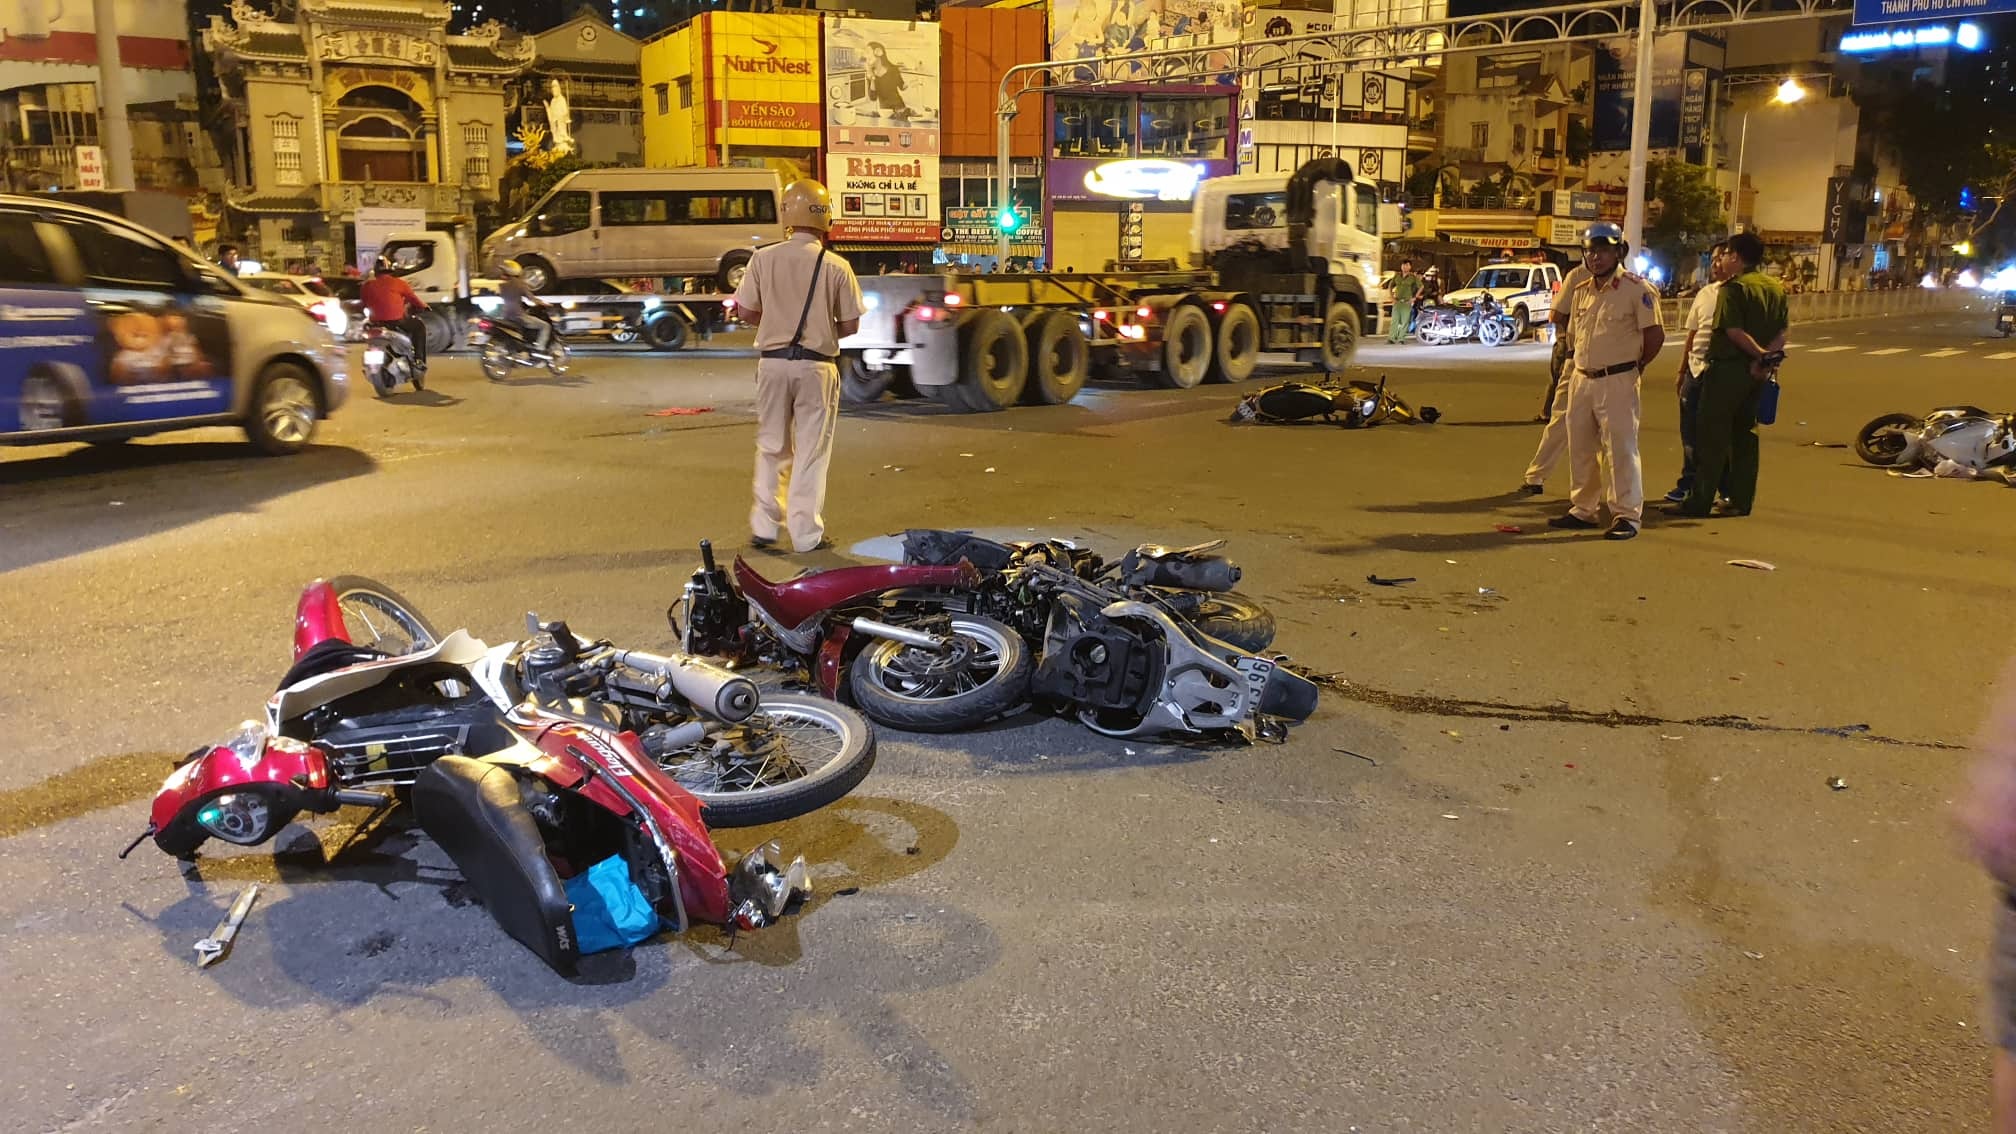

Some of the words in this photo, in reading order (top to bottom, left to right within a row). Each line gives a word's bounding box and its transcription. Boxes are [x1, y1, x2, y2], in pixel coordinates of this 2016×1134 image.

[723, 54, 811, 75] NutriNest
[742, 103, 767, 116] YẾN
[770, 103, 796, 117] SÀO
[846, 157, 922, 178] Rinnai
[846, 180, 876, 190] KHÔNG
[878, 179, 892, 190] CHỈ
[894, 179, 905, 190] LÀ
[1831, 182, 1844, 238] VICHY
